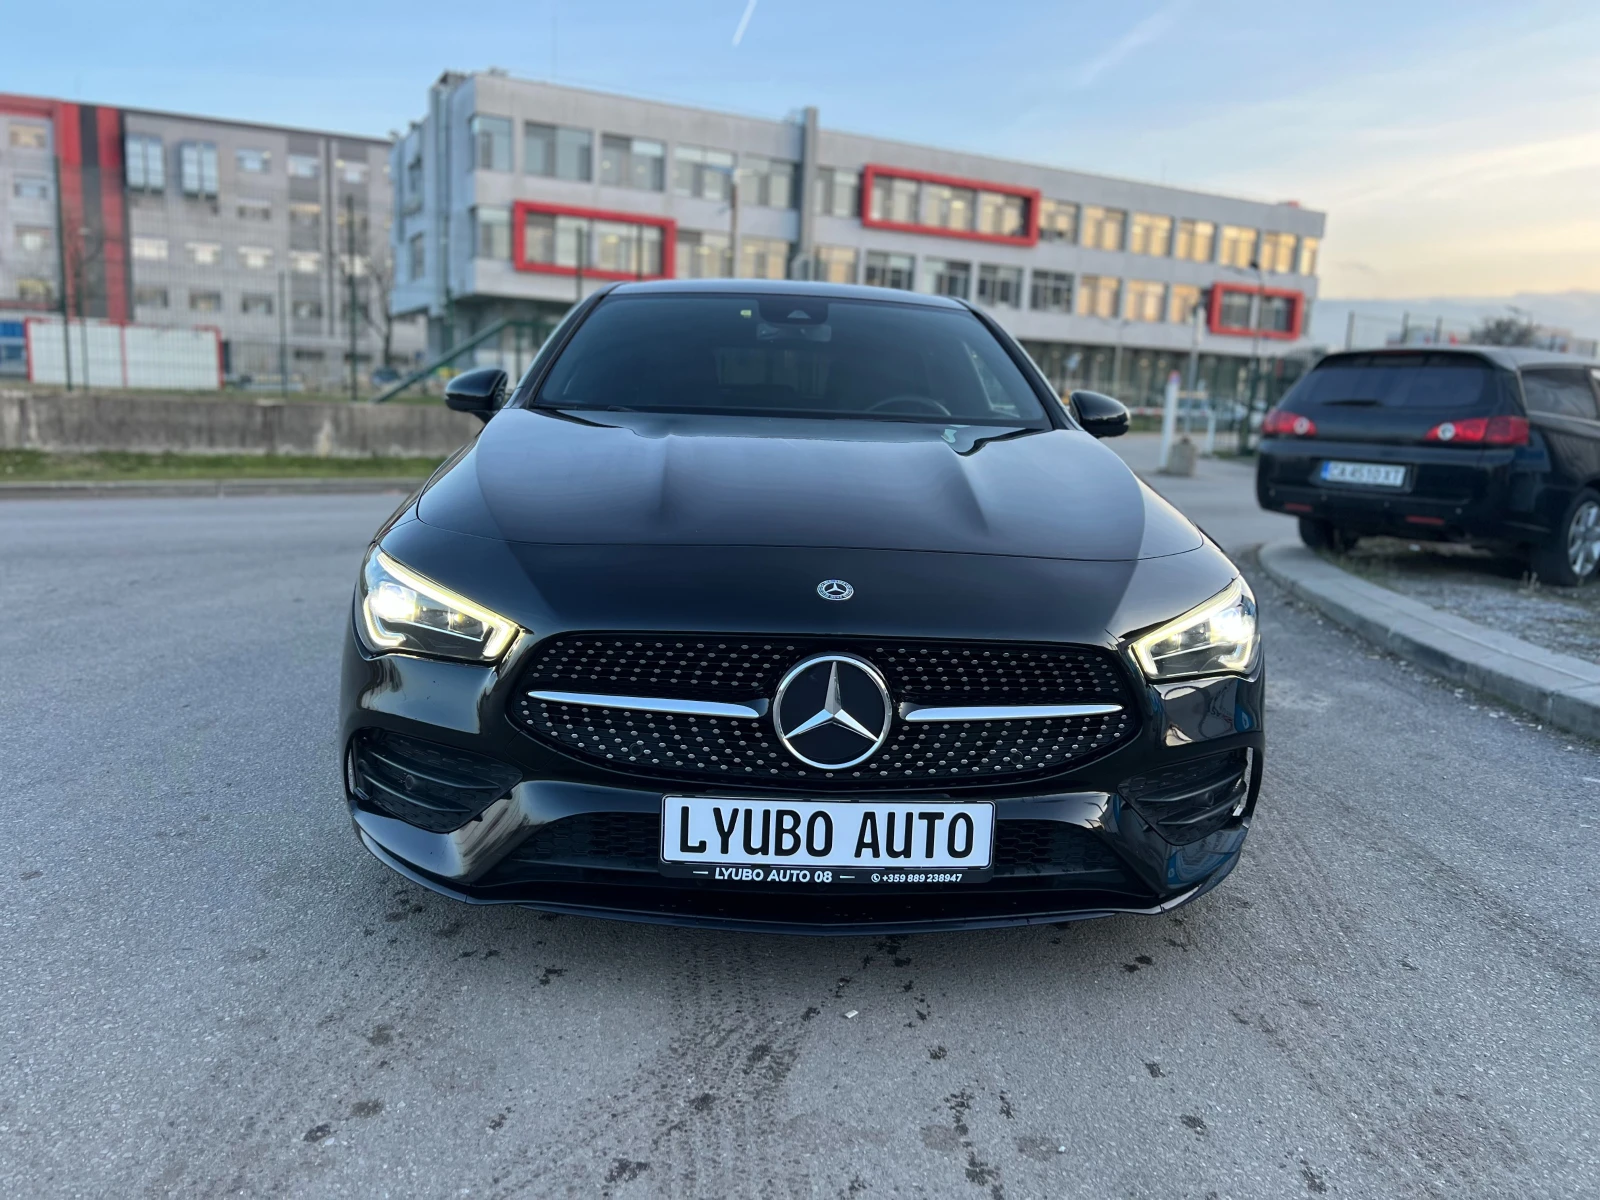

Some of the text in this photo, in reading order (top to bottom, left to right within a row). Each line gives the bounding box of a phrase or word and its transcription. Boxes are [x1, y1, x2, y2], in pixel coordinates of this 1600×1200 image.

[680, 805, 974, 859] LYUBO AUTO
[714, 867, 833, 883] LYUBO AUTO 08
[882, 873, 963, 883] +359 889 238947
